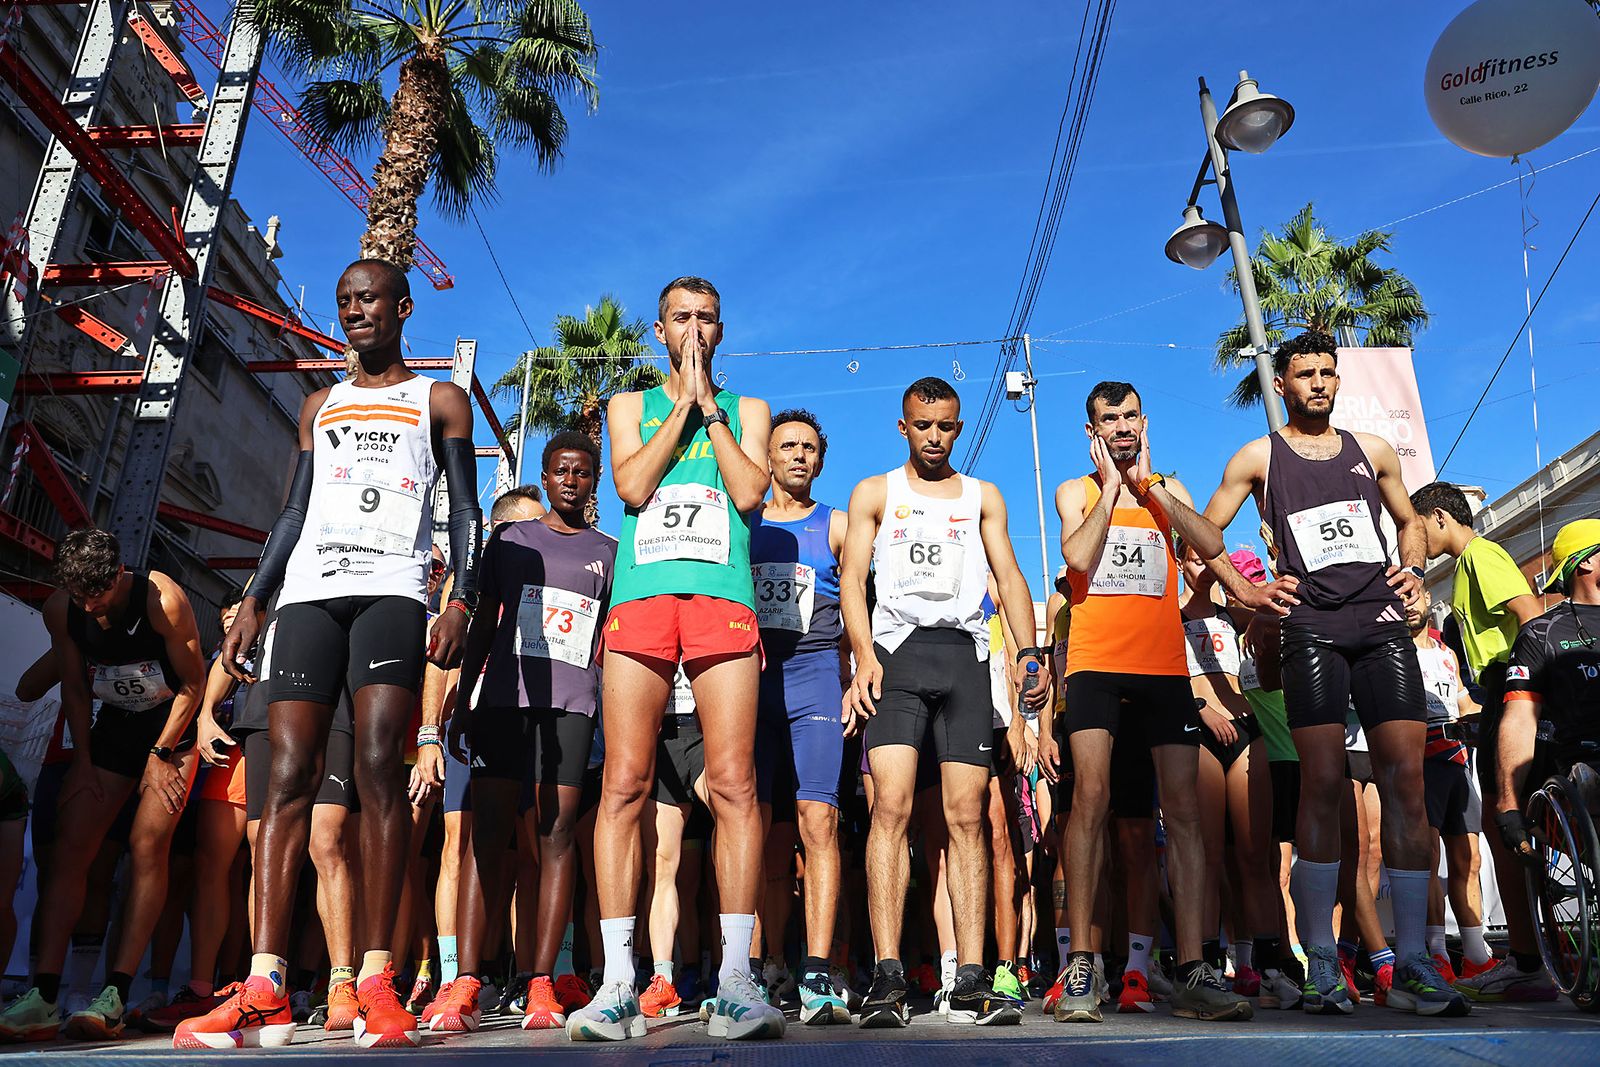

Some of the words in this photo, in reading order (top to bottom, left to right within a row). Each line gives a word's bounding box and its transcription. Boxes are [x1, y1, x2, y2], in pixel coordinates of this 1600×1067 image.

[1441, 50, 1559, 91] Goldfitness
[1460, 94, 1483, 106] Calle
[1485, 89, 1511, 102] Rico,
[1513, 83, 1529, 95] 22
[1333, 395, 1385, 419] ERIA
[1388, 409, 1411, 420] 2025
[354, 431, 401, 444] VICKY
[356, 443, 393, 453] FOODS
[334, 466, 353, 479] 2K
[400, 477, 419, 494] 2K
[358, 487, 381, 513] 9
[649, 490, 662, 504] K
[705, 489, 722, 504] 2K
[1347, 502, 1362, 513] 2K
[662, 503, 702, 529] 57
[893, 527, 908, 539] 2K
[947, 528, 961, 541] 2K
[1319, 518, 1354, 541] 56
[638, 535, 677, 546] CUESTAS
[678, 534, 722, 546] CARDOZO
[909, 542, 942, 566] 68
[1111, 544, 1146, 568] 54
[1308, 550, 1344, 567] Huelva
[796, 566, 811, 579] 2K
[1091, 579, 1125, 588] Huelva
[527, 587, 543, 600] 2K
[580, 598, 594, 613] 2K
[545, 607, 574, 634] 73
[1195, 633, 1225, 653] 76
[139, 662, 156, 673] 2K
[112, 679, 146, 696] 65
[1434, 681, 1450, 698] 17
